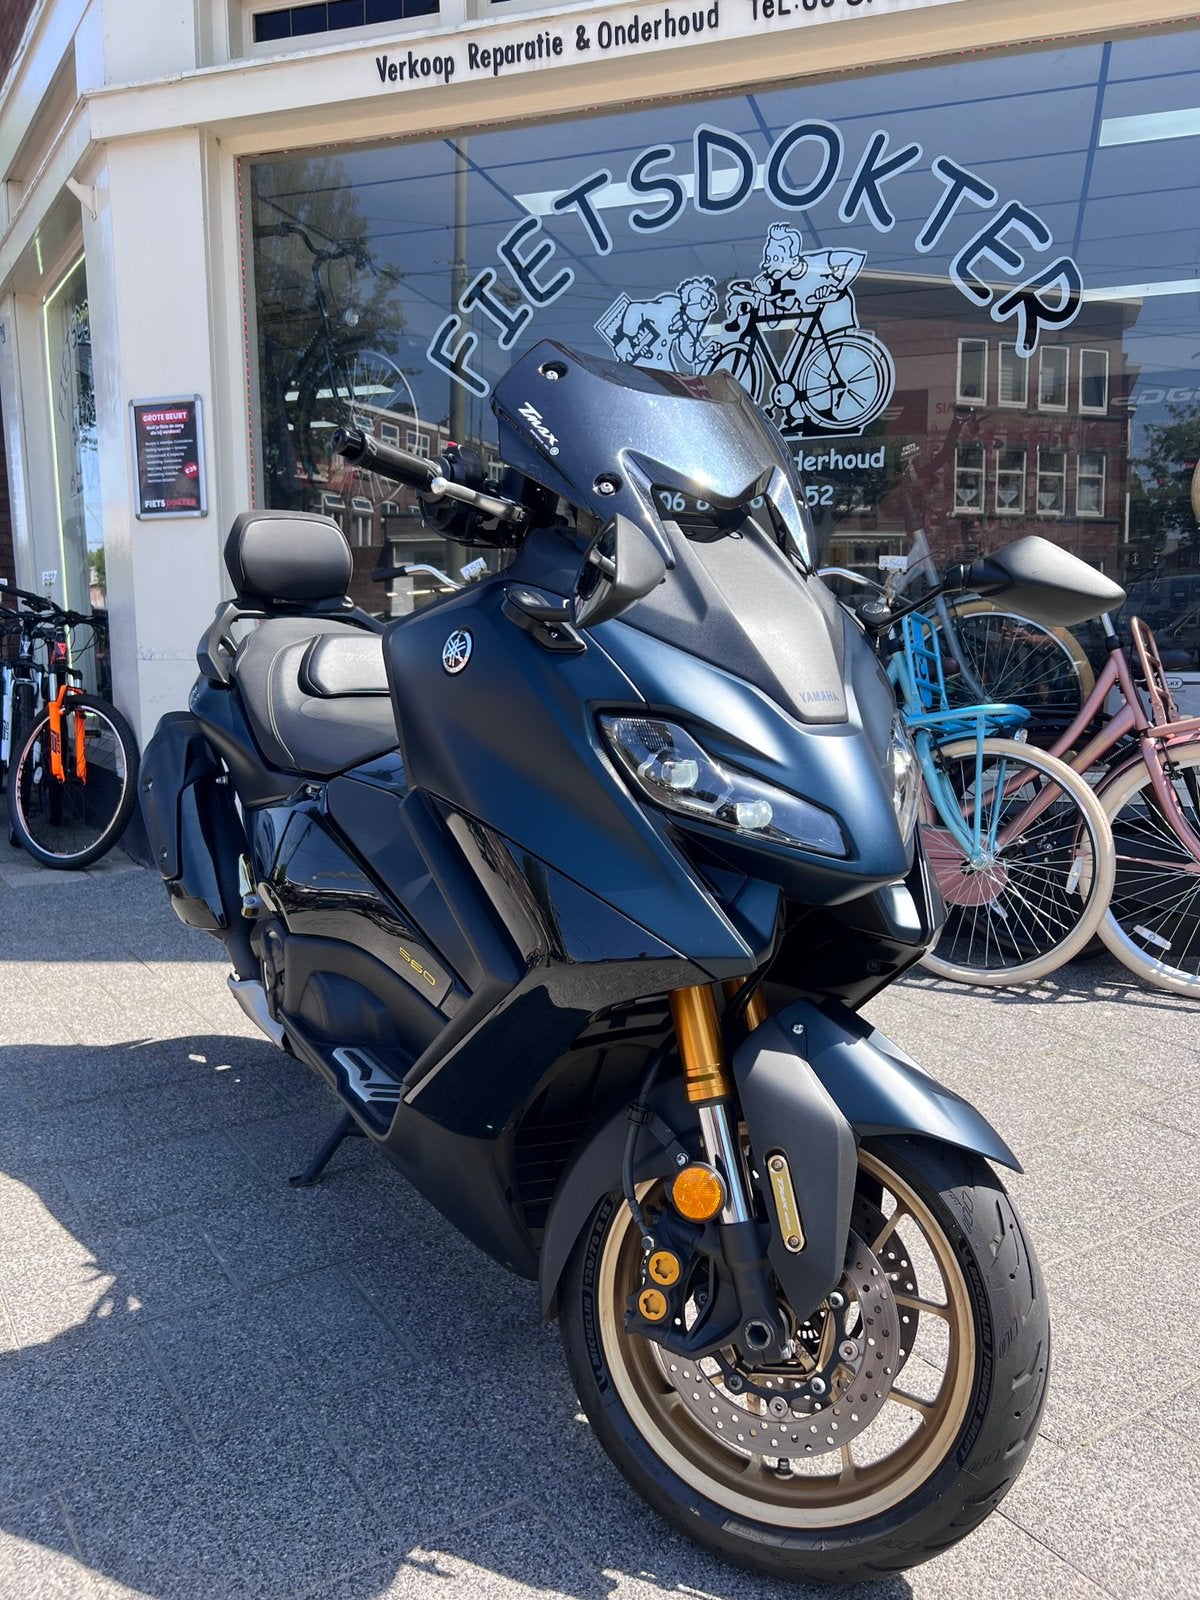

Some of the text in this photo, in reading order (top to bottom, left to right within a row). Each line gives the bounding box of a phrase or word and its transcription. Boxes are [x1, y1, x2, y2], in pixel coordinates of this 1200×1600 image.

[376, 51, 455, 83] Verkoop
[467, 31, 563, 76] Reparatie
[575, 25, 591, 50] &
[597, 1, 719, 49] Onderhoud
[427, 119, 1083, 398] FIETSDOKTER
[143, 412, 187, 422] GROTE BEURT
[794, 446, 886, 472] derhoud
[806, 485, 834, 507] 52
[798, 690, 840, 703] YAMAHA
[583, 1294, 602, 1367] MICHELIN
[968, 1266, 993, 1344] MICHELIN
[976, 1355, 993, 1414] POWER
